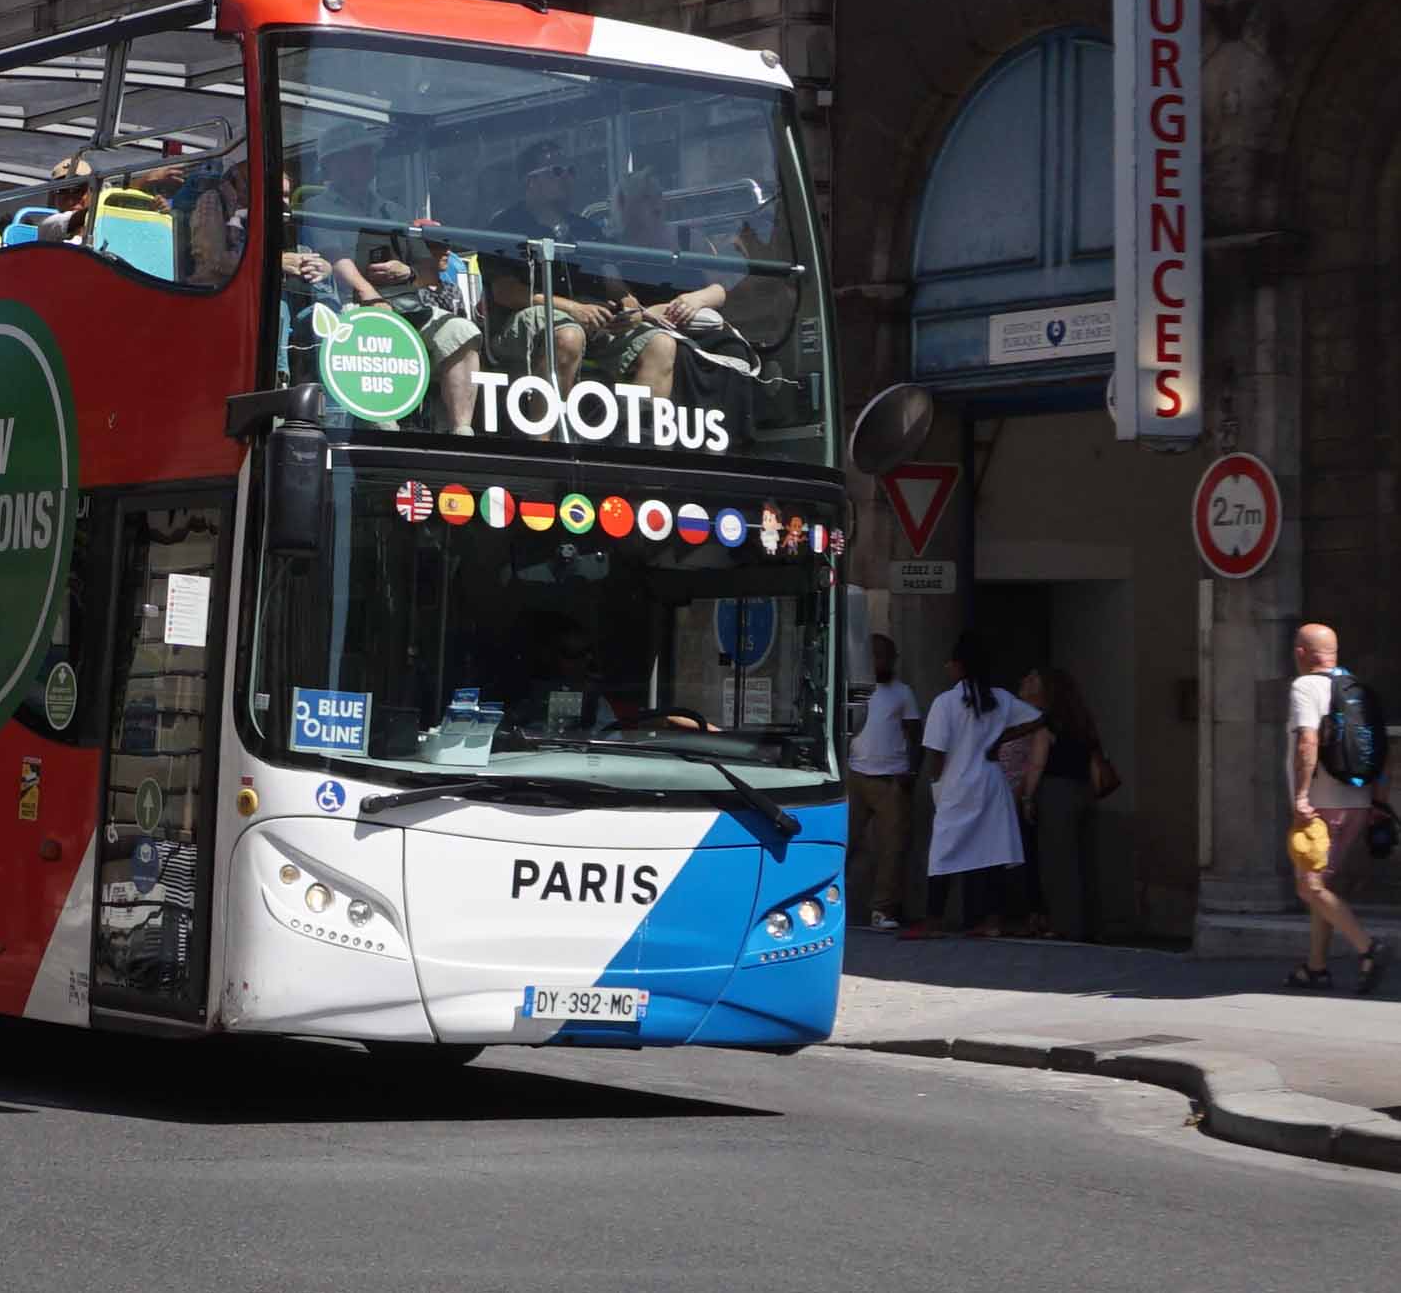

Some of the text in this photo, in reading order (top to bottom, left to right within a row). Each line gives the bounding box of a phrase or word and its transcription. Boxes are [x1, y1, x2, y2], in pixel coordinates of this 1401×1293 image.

[358, 335, 392, 354] LOW
[332, 354, 420, 376] EMISSIONS
[361, 375, 394, 394] BUS
[318, 698, 363, 718] BLUE
[321, 724, 362, 744] LINE
[511, 859, 658, 905] PARIS
[536, 991, 634, 1016] DY-392-MG
